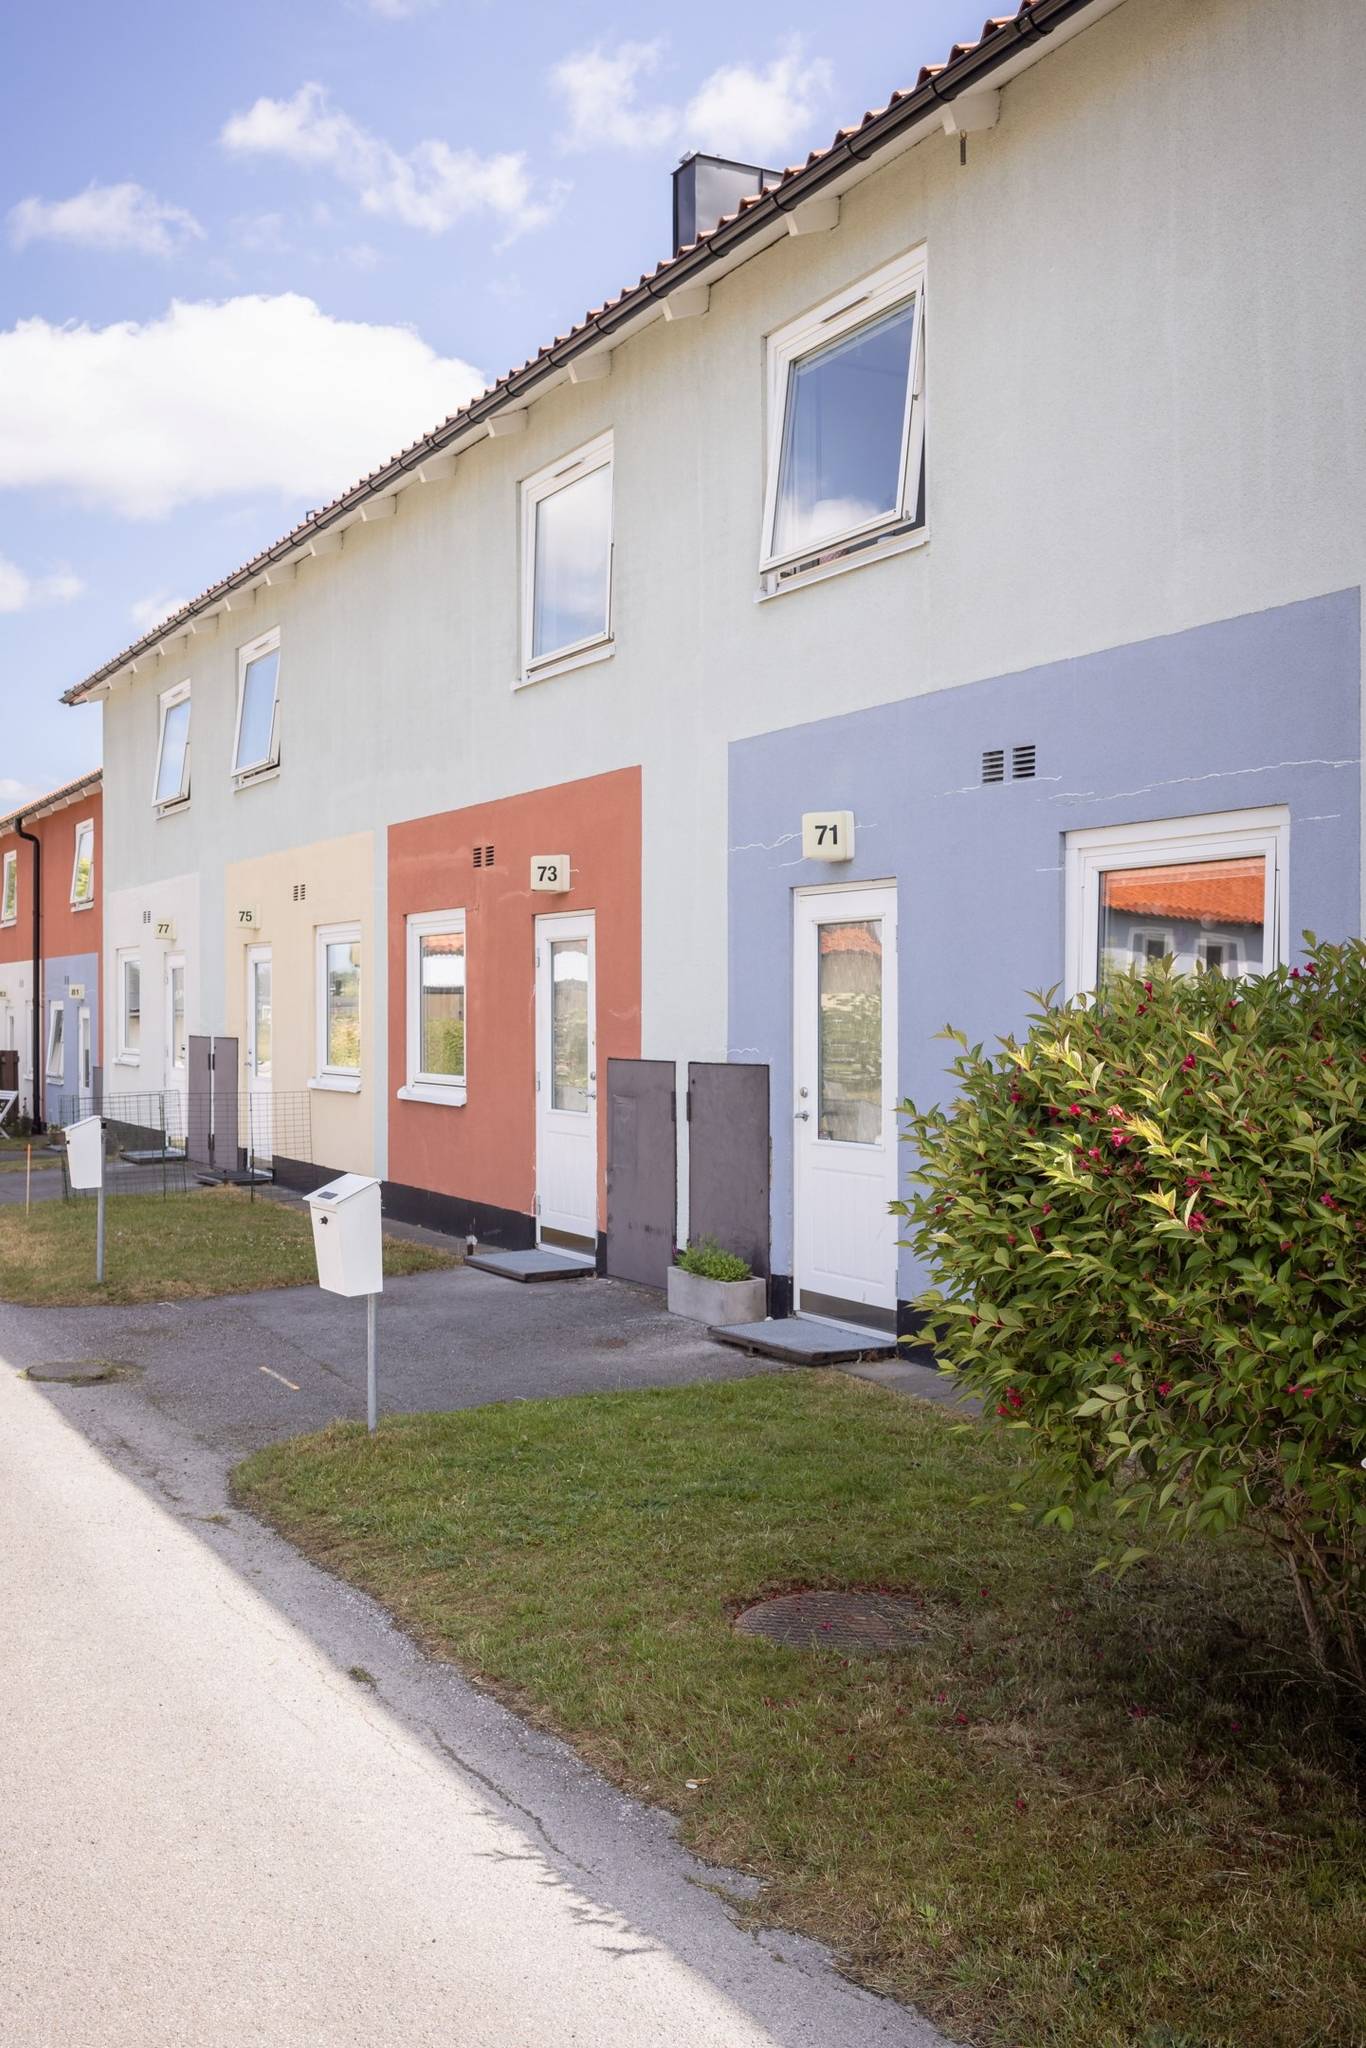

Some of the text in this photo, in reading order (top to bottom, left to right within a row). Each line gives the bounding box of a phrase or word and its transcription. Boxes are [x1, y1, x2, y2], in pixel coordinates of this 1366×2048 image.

[815, 825, 838, 845] 71
[537, 866, 558, 881] 73
[239, 911, 252, 922] 75
[157, 924, 169, 933] 77
